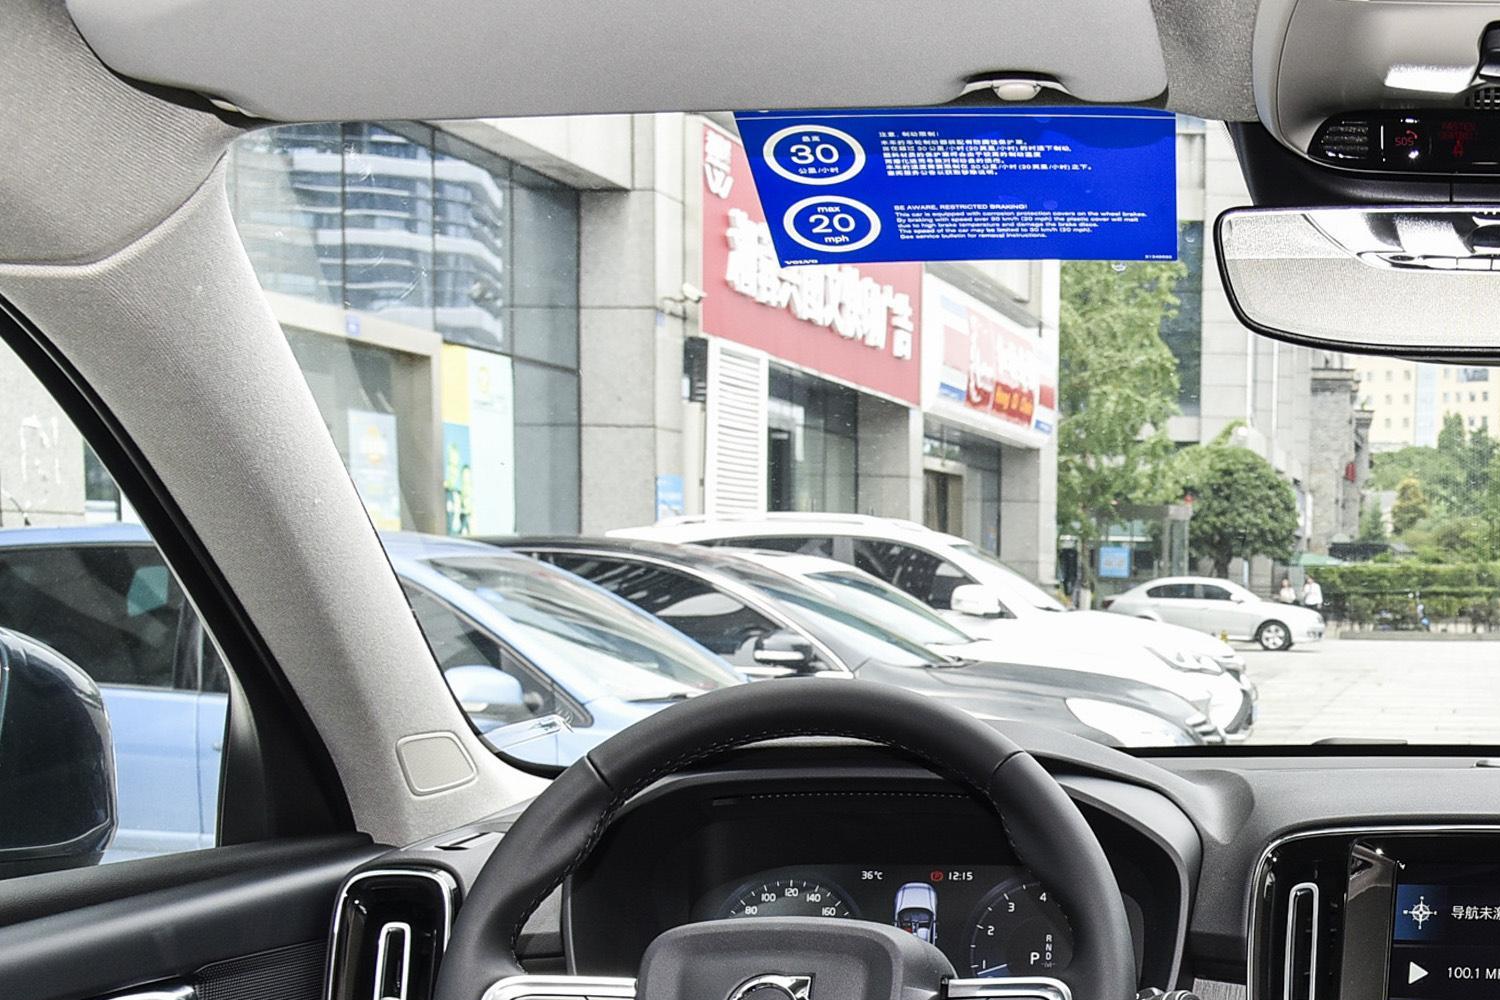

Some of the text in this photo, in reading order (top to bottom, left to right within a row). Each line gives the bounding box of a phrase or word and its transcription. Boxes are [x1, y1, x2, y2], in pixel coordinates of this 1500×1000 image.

[1395, 137, 1414, 146] SOS
[790, 144, 839, 165] 30
[808, 213, 856, 233] 20
[824, 235, 850, 244] mph
[861, 871, 883, 880] 36°C
[948, 872, 974, 881] 12:15
[785, 888, 799, 897] 120
[1040, 892, 1047, 902] 4
[761, 893, 776, 902] 100
[806, 894, 821, 903] 140
[745, 906, 758, 915] 80
[822, 907, 836, 916] 160
[1008, 902, 1015, 912] 3
[987, 925, 995, 936] 2
[1046, 934, 1053, 942] R
[1045, 943, 1053, 951] N
[1030, 952, 1040, 965] P
[1045, 952, 1052, 960] D
[1448, 966, 1480, 979] 100.1
